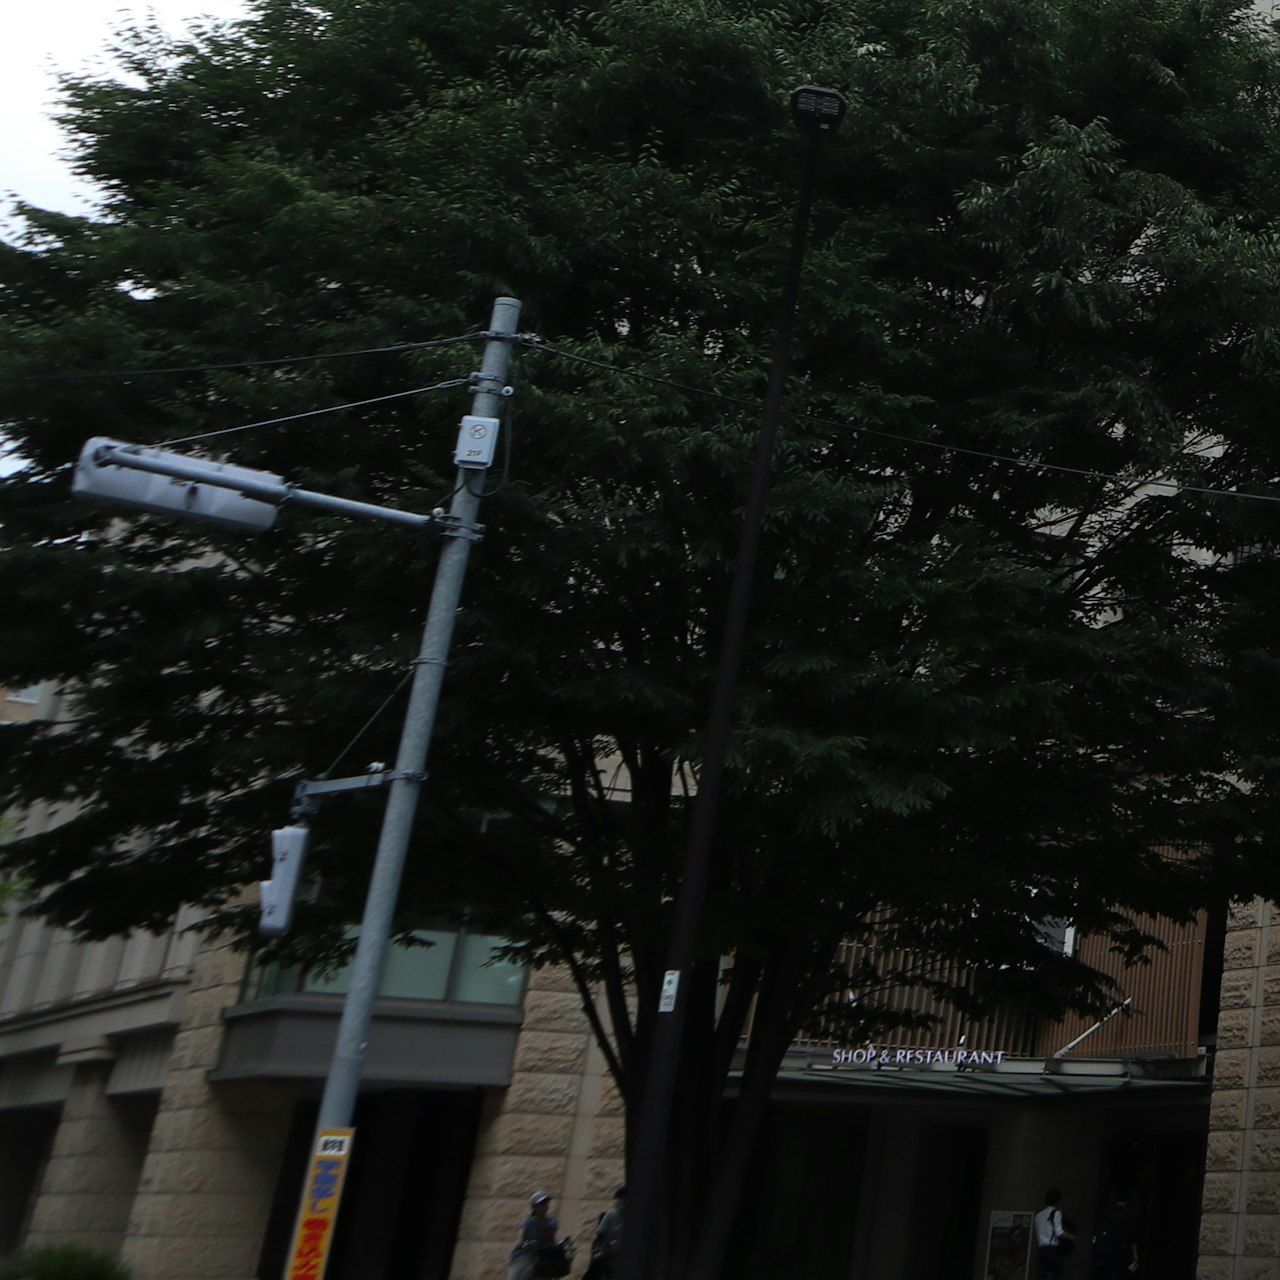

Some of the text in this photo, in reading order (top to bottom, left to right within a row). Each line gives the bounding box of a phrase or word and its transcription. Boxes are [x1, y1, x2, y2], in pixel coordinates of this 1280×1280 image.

[832, 1048, 1005, 1065] SHOP & RESTAURANT
